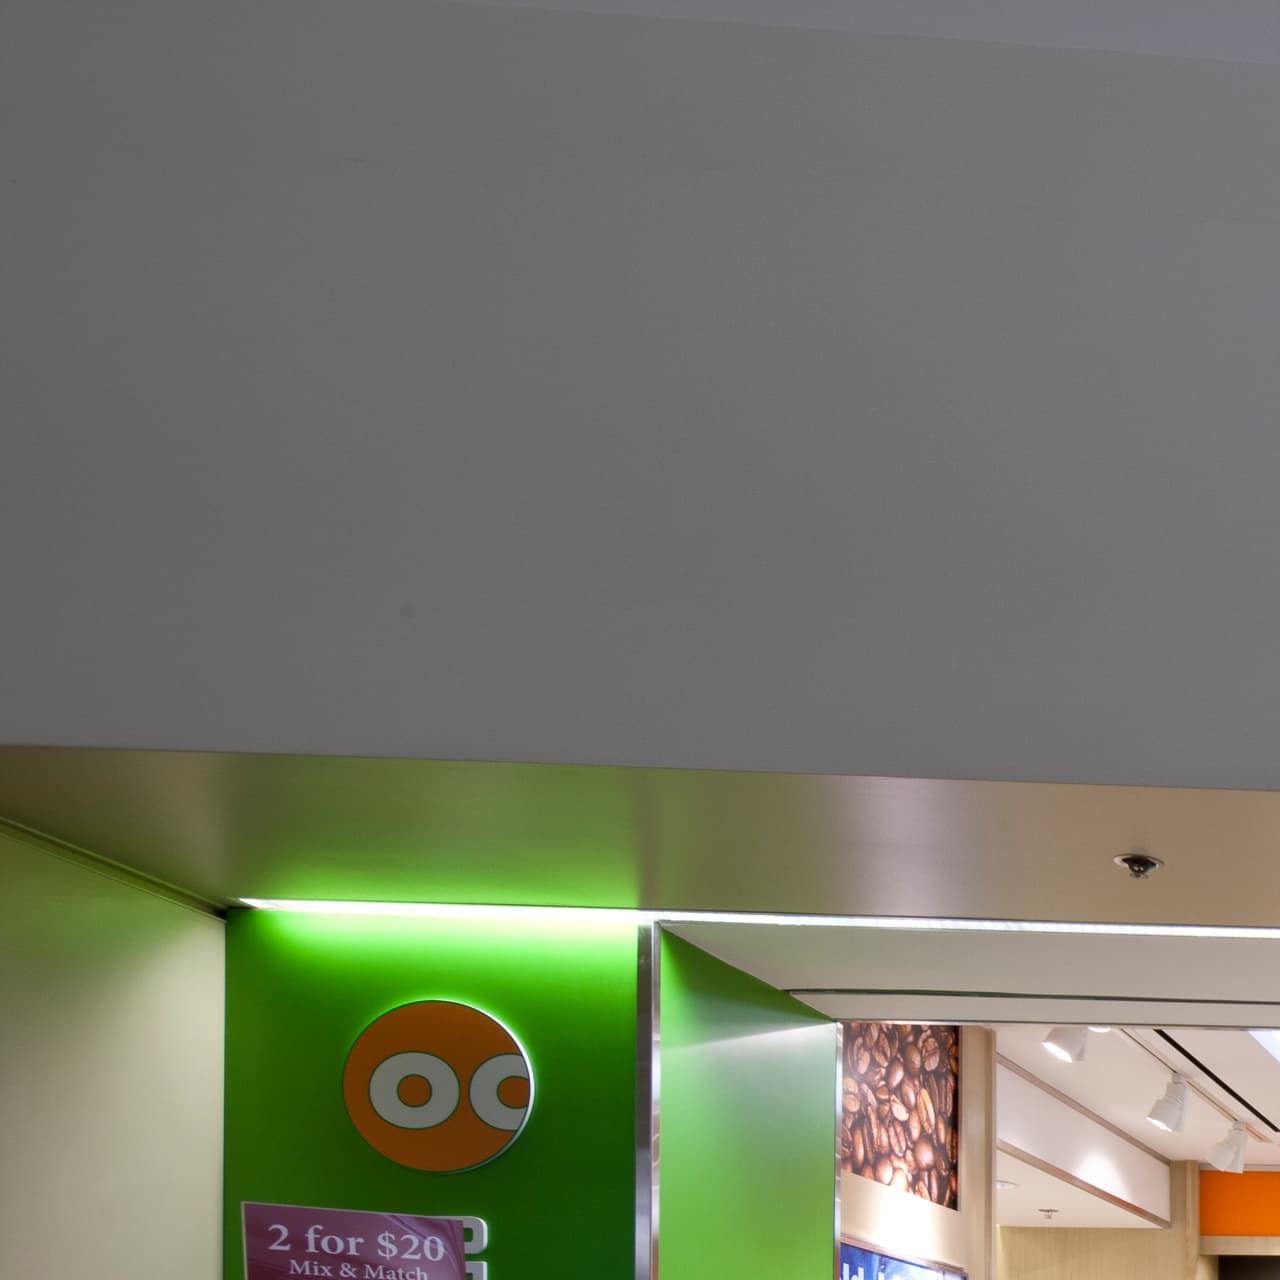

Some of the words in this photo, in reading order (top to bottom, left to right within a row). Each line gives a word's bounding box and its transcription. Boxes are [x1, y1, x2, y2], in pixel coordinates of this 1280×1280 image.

[267, 1223, 291, 1251] 2
[304, 1224, 364, 1256] for
[377, 1230, 446, 1262] $20
[289, 1259, 333, 1277] Mix
[339, 1262, 358, 1278] &
